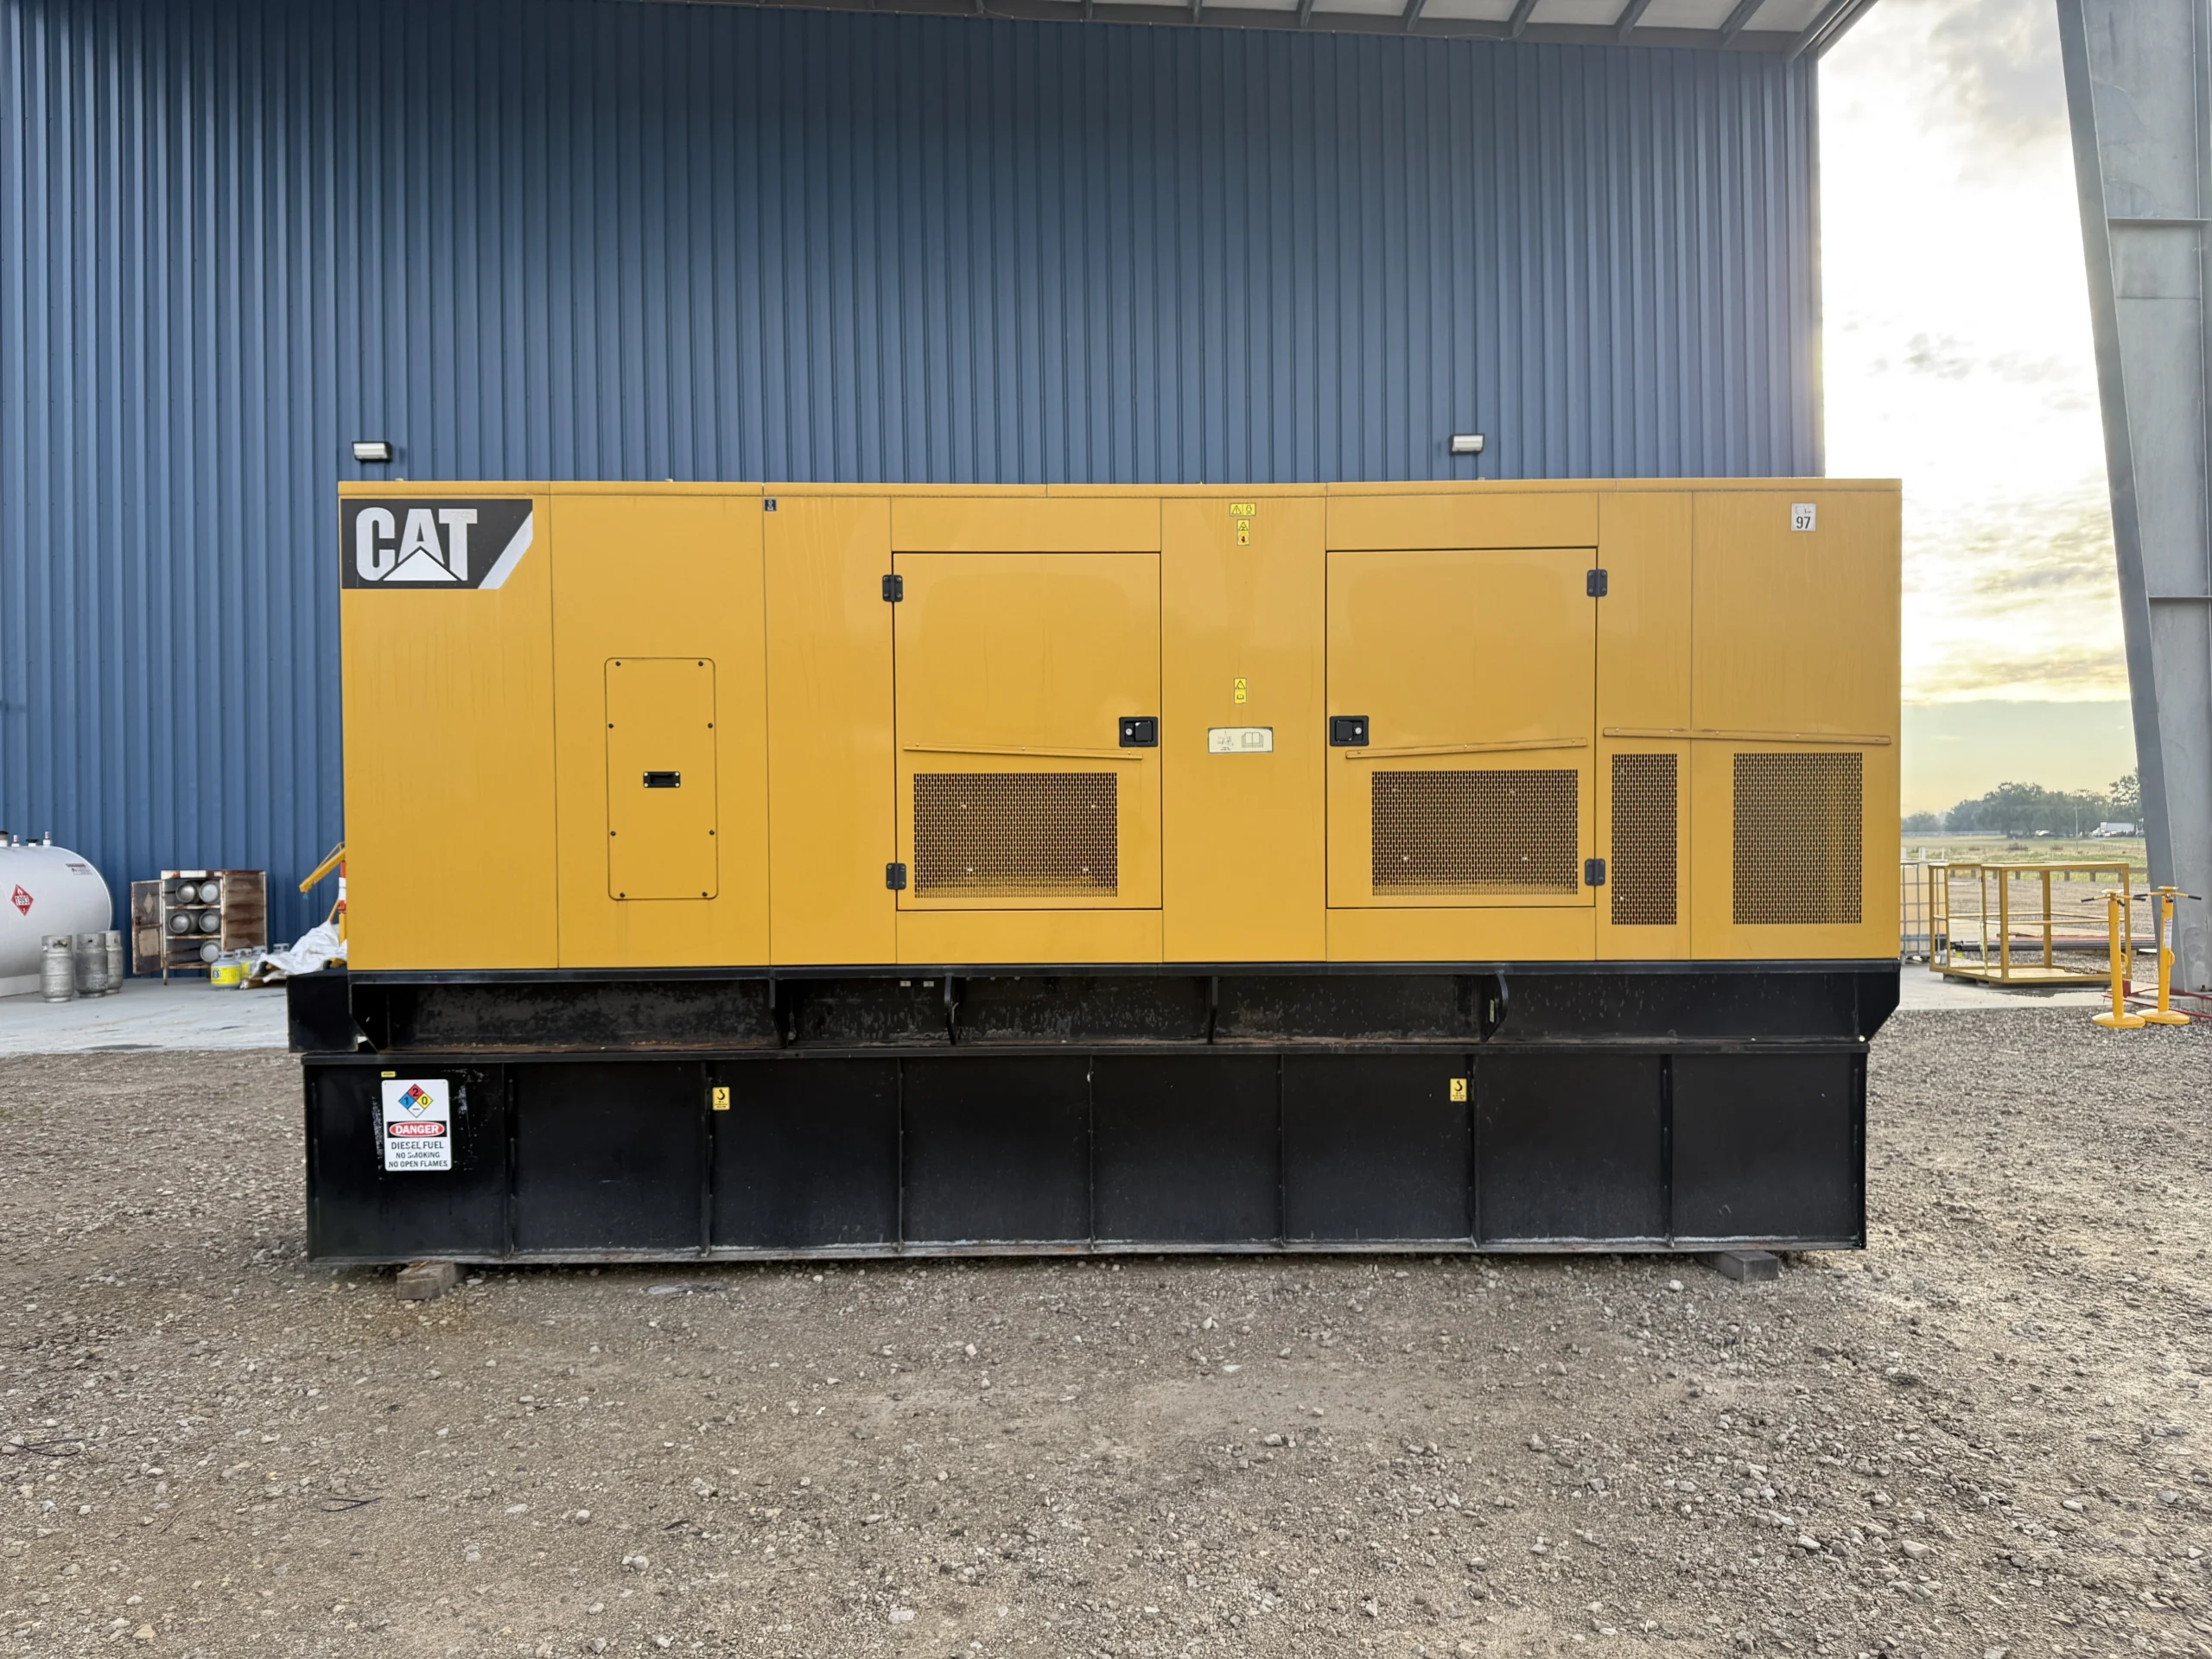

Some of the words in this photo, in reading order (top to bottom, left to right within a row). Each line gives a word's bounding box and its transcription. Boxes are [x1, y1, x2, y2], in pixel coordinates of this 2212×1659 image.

[1796, 516, 1811, 529] 97
[356, 506, 478, 582] CAT
[16, 896, 29, 905] 1993
[412, 1088, 419, 1096] 2
[404, 1096, 409, 1105] 1
[421, 1096, 428, 1105] 0
[395, 1125, 439, 1135] DANGER
[391, 1141, 421, 1150] DIESEL
[423, 1141, 444, 1149] FUEL
